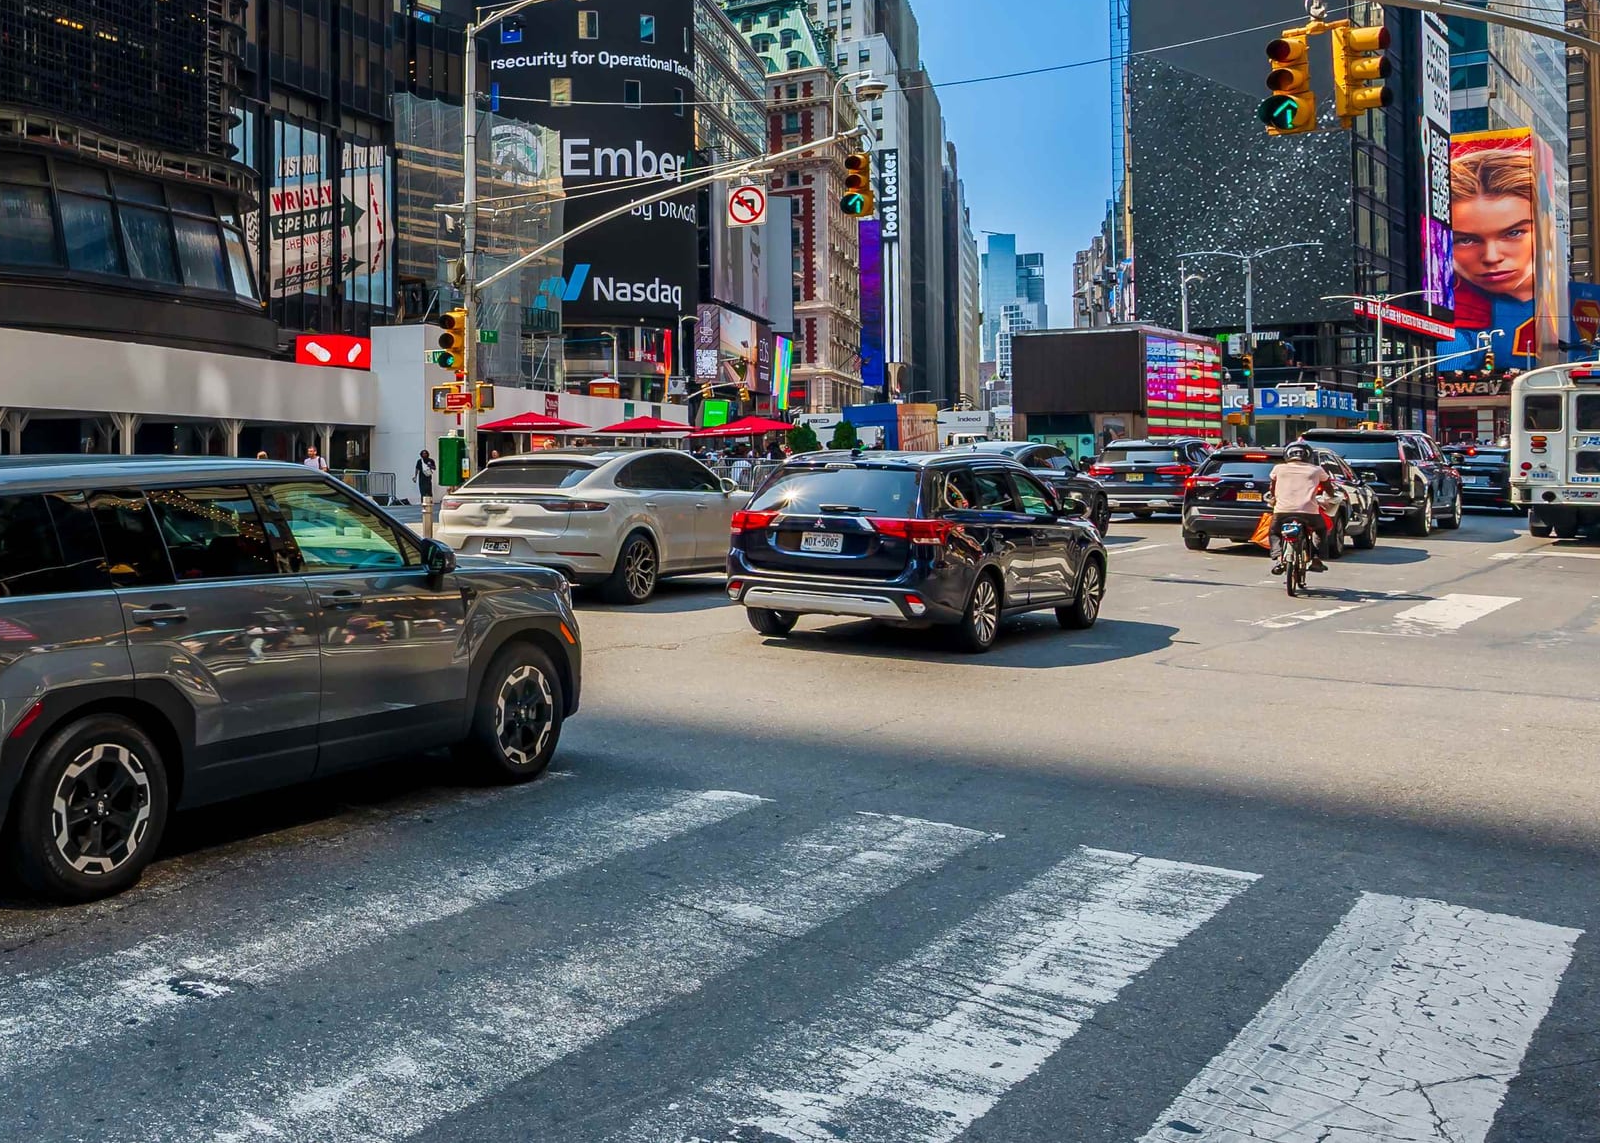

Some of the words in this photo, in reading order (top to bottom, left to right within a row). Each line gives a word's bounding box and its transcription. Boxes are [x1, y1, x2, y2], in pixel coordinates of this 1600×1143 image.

[570, 50, 595, 66] for
[598, 51, 673, 73] Operational
[1426, 34, 1448, 71] TICKETS
[1426, 60, 1448, 95] COMING
[1433, 90, 1448, 119] SOON
[562, 138, 686, 184] Ember
[630, 198, 652, 221] by
[882, 206, 898, 238] Foot
[593, 276, 682, 312] Nasdaq
